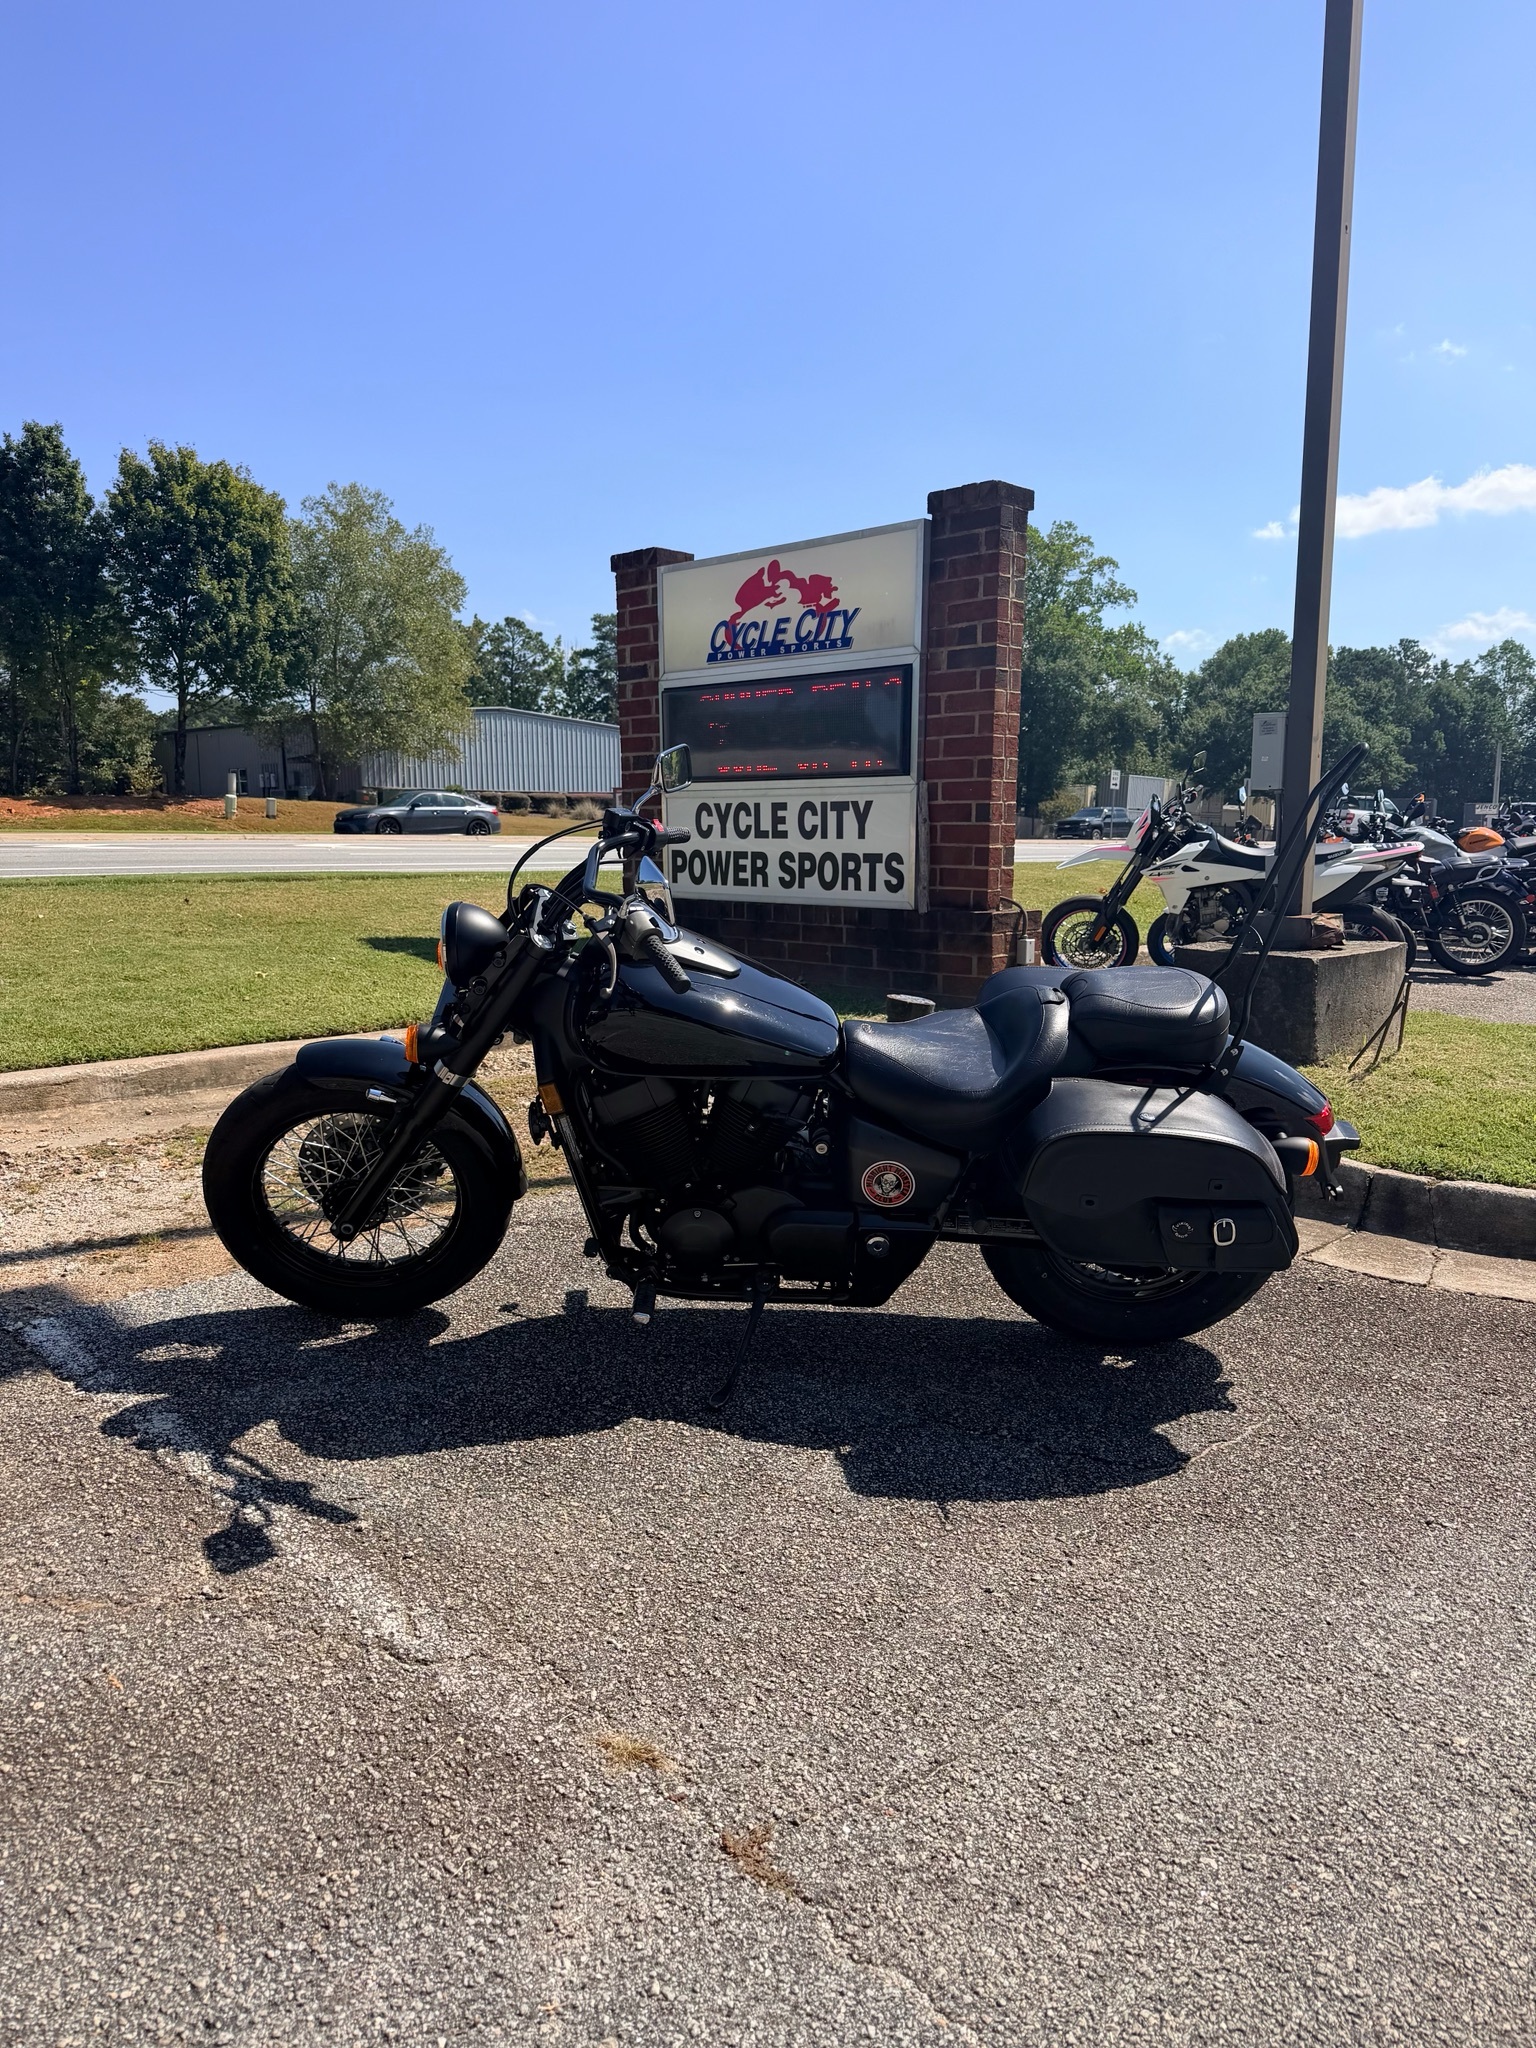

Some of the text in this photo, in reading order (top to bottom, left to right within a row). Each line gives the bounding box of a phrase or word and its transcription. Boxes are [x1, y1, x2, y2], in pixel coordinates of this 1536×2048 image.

[710, 607, 862, 652] CYCLE CITY
[717, 639, 843, 661] POWER SPORTS
[695, 800, 874, 840] CYCLE CITY
[671, 849, 905, 894] POWER SPORTS
